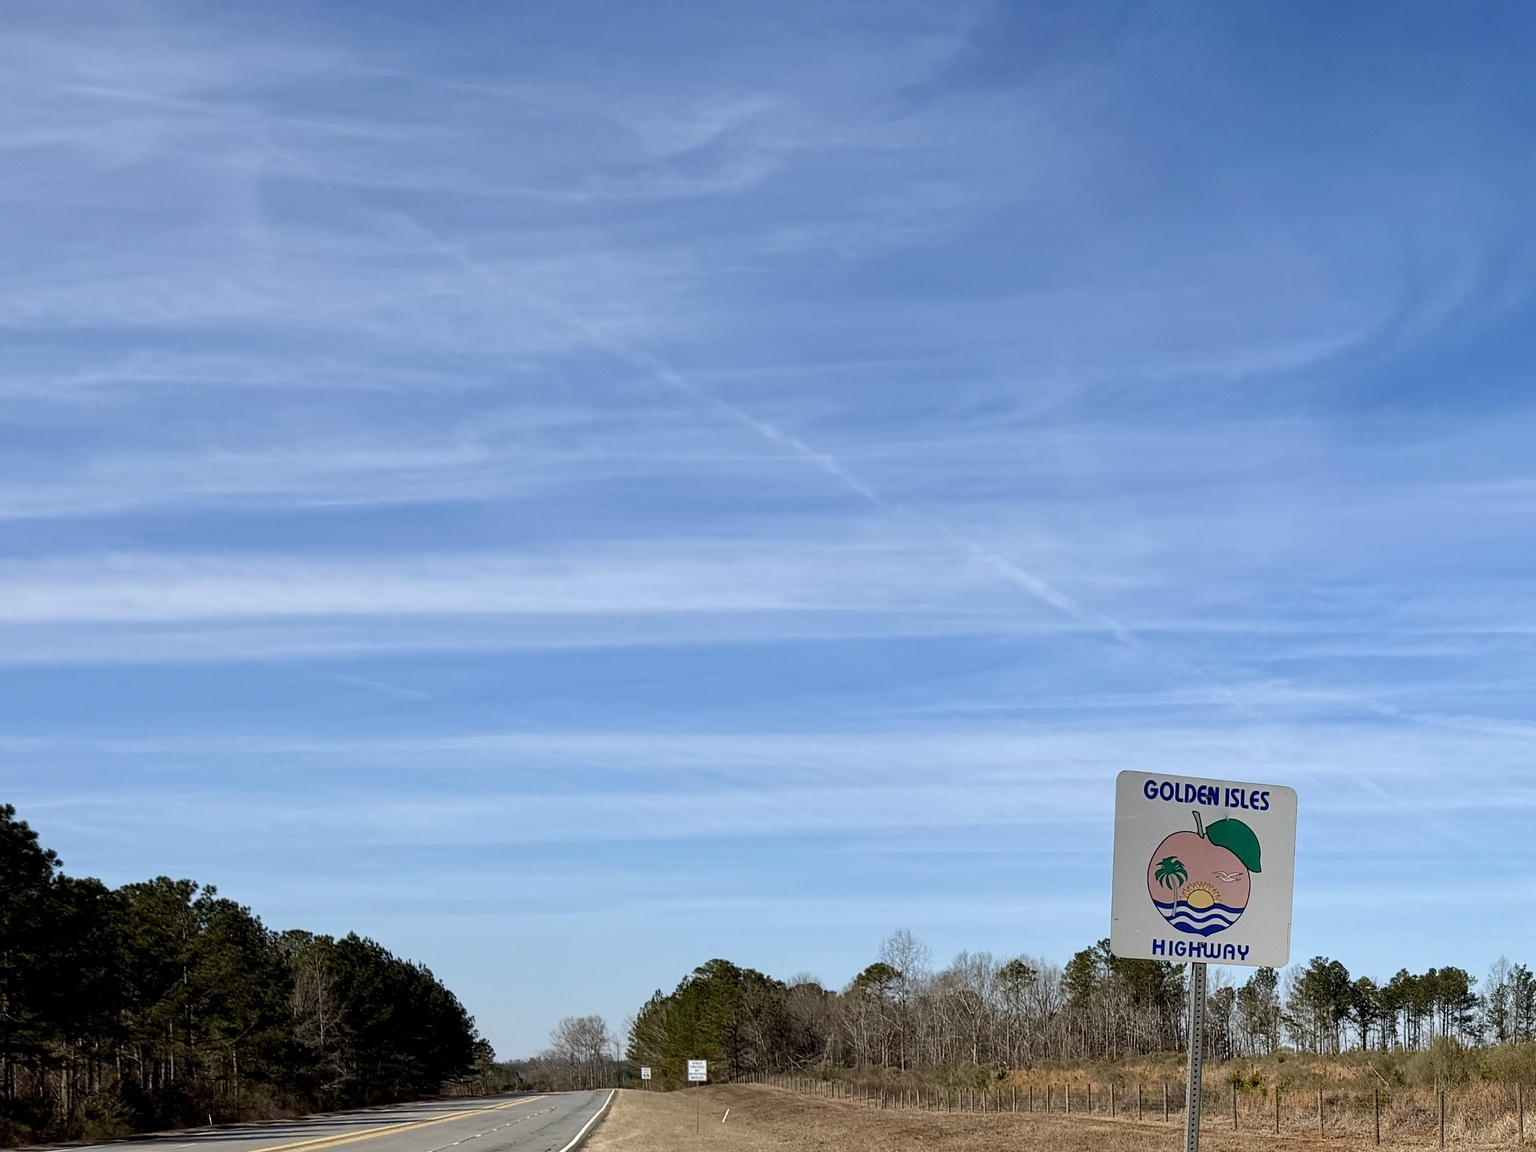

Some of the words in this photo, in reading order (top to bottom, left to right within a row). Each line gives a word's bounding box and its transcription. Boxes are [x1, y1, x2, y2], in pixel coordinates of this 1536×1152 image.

[1143, 779, 1219, 806] GOLDEN
[1225, 788, 1270, 811] ISLES
[1152, 938, 1250, 961] HIGHWAY
